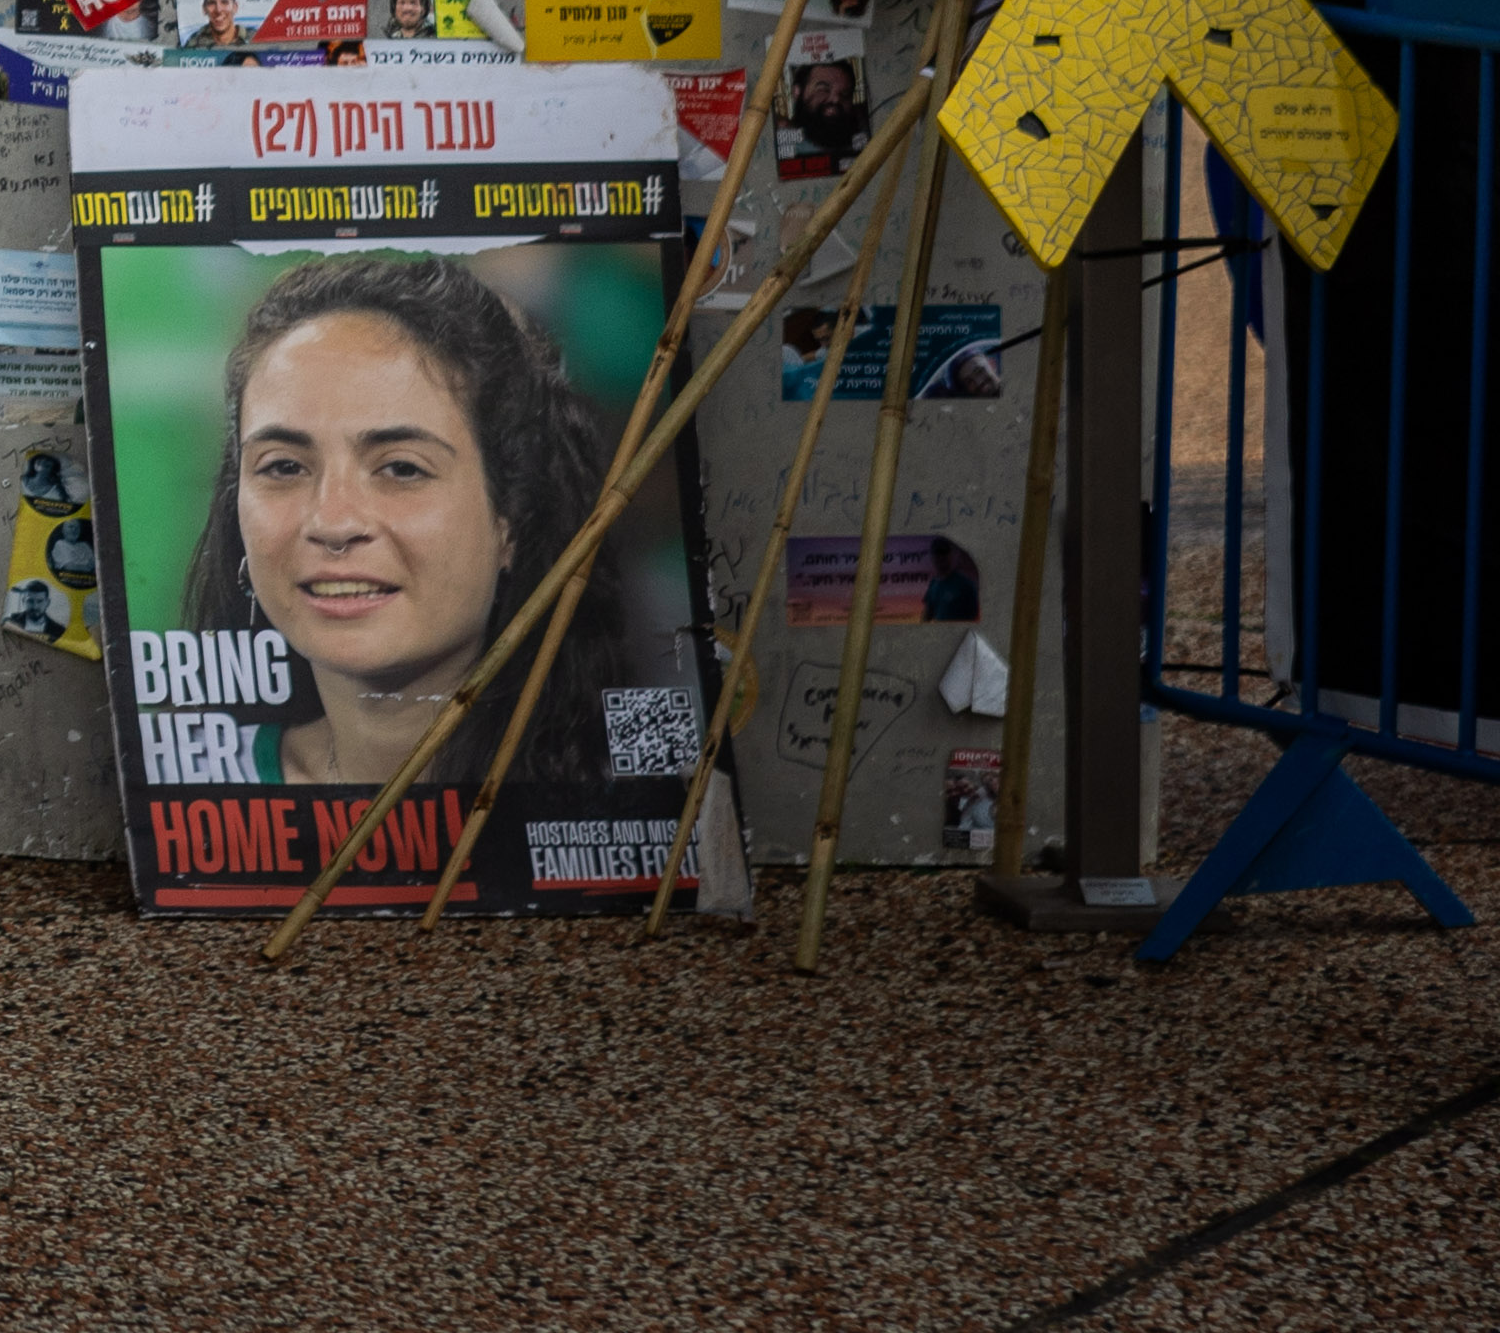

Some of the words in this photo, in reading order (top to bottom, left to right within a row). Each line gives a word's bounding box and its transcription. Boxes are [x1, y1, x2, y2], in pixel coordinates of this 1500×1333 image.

[286, 6, 321, 24] דושי
[327, 4, 366, 21] רותם
[370, 51, 403, 64] ביבר
[409, 48, 456, 64] בשביל
[461, 51, 516, 64] מנצחים
[252, 98, 318, 159] (27)
[328, 100, 405, 159] הימן
[414, 100, 496, 151] ענבר
[248, 179, 440, 224] #מהעםהחטופים
[473, 175, 663, 221] #מהעםהחטופים
[129, 629, 292, 707] BRING
[138, 711, 246, 785] HER
[150, 797, 304, 875] HOME
[527, 821, 610, 849] HOSTAGES
[611, 821, 646, 848] AND
[531, 845, 637, 882] FAMILIES
